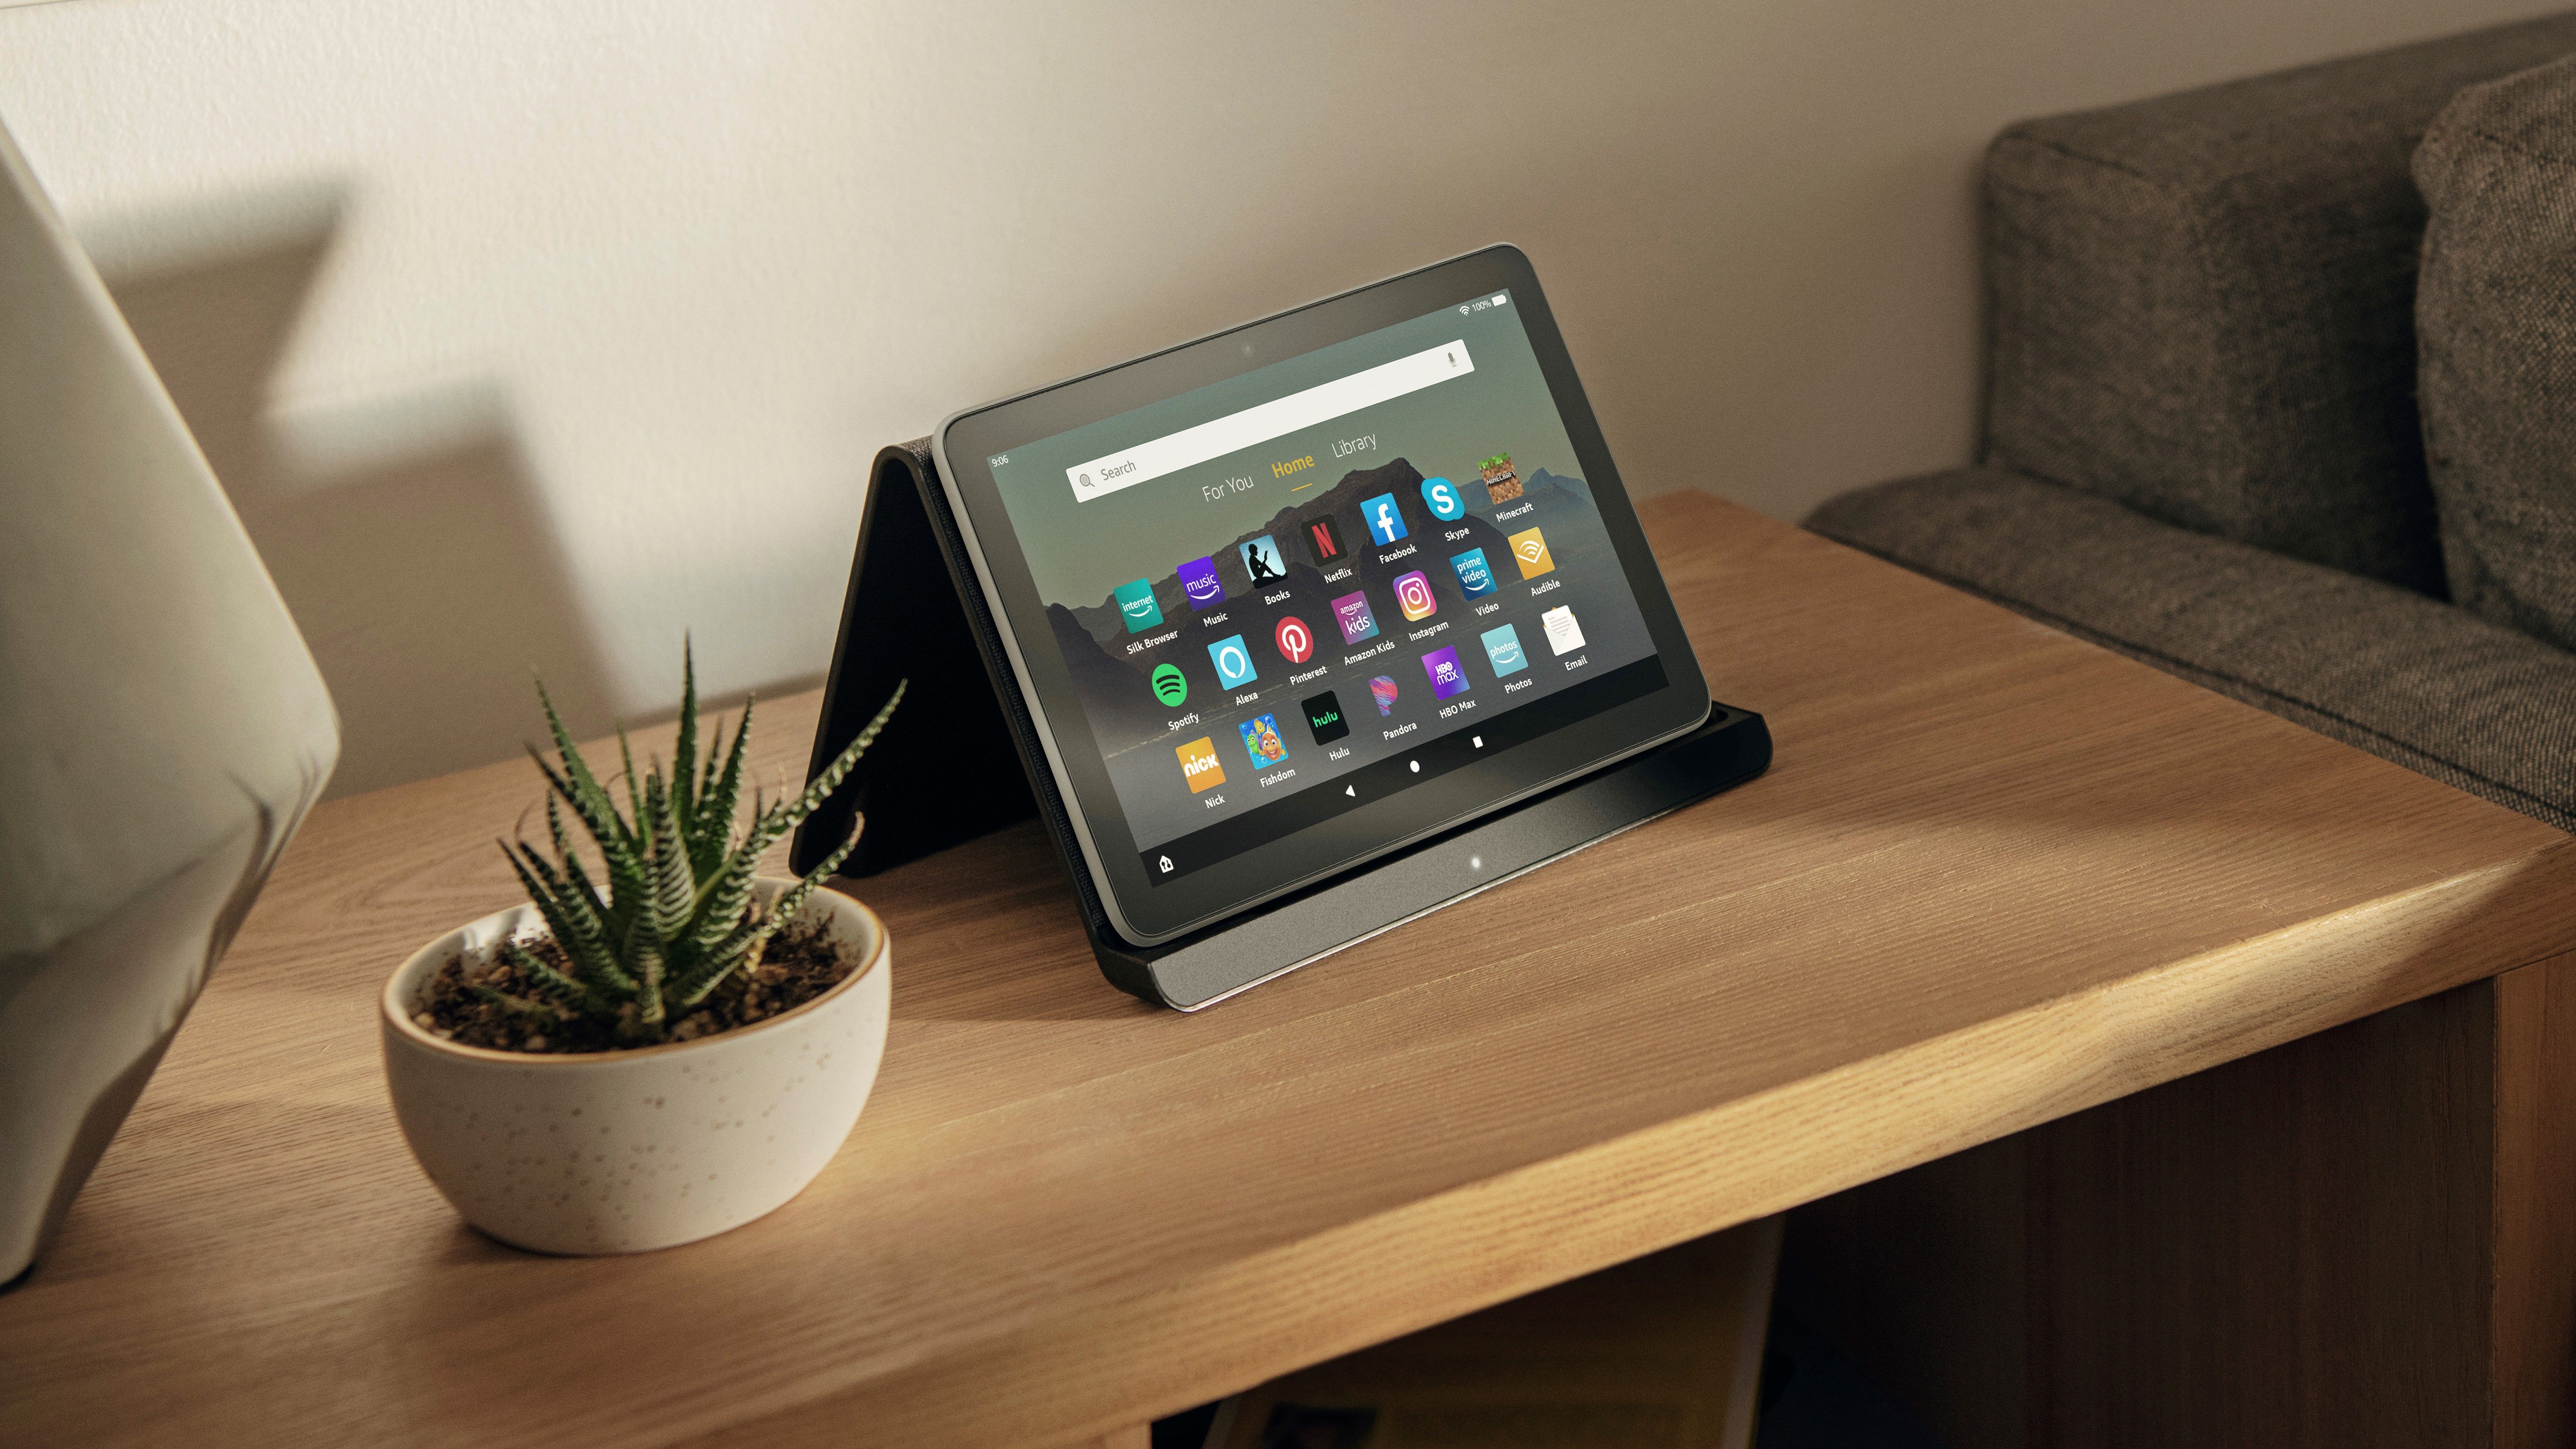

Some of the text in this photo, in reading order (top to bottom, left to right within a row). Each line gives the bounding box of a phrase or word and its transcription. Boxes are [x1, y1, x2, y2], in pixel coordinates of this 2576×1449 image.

[1472, 300, 1491, 312] 100%
[1332, 434, 1376, 458] Library
[992, 455, 1009, 467] 9:06
[1271, 455, 1315, 478] Home
[1101, 460, 1136, 481] Search
[1486, 471, 1516, 486] MINECRAFT
[1202, 475, 1254, 502] For You
[1496, 502, 1534, 522] Minecraft
[1445, 527, 1470, 541] Skype
[1379, 544, 1417, 564] Facebook
[1457, 556, 1482, 574] prime
[1186, 573, 1216, 593] music
[1324, 568, 1353, 584] Netflix
[1461, 568, 1486, 584] video
[1531, 580, 1561, 596] Audible
[1121, 595, 1154, 612] internet
[1264, 590, 1290, 605] Books
[1340, 600, 1363, 614] amazon
[1475, 603, 1499, 616] Video
[1203, 612, 1228, 627] Music
[1345, 615, 1370, 635] kids
[1409, 621, 1449, 641] Instagram
[1126, 630, 1178, 654] Silk Browser
[1490, 640, 1517, 659] photos
[1344, 640, 1395, 666] Amazon Kids
[1435, 661, 1453, 675] HBO
[1564, 655, 1588, 671] Email
[1290, 665, 1327, 685] Pinterest
[1437, 669, 1460, 685] max
[1504, 677, 1533, 694] Photos
[1236, 691, 1259, 706] Alexa
[1439, 699, 1477, 719] HBO Max
[1168, 712, 1199, 731] Spotify
[1312, 712, 1338, 728] hulu
[1383, 722, 1417, 740] Pandora
[1329, 747, 1350, 761] Hulu
[1259, 768, 1296, 787] Fishdom
[1204, 794, 1225, 809] Nick
